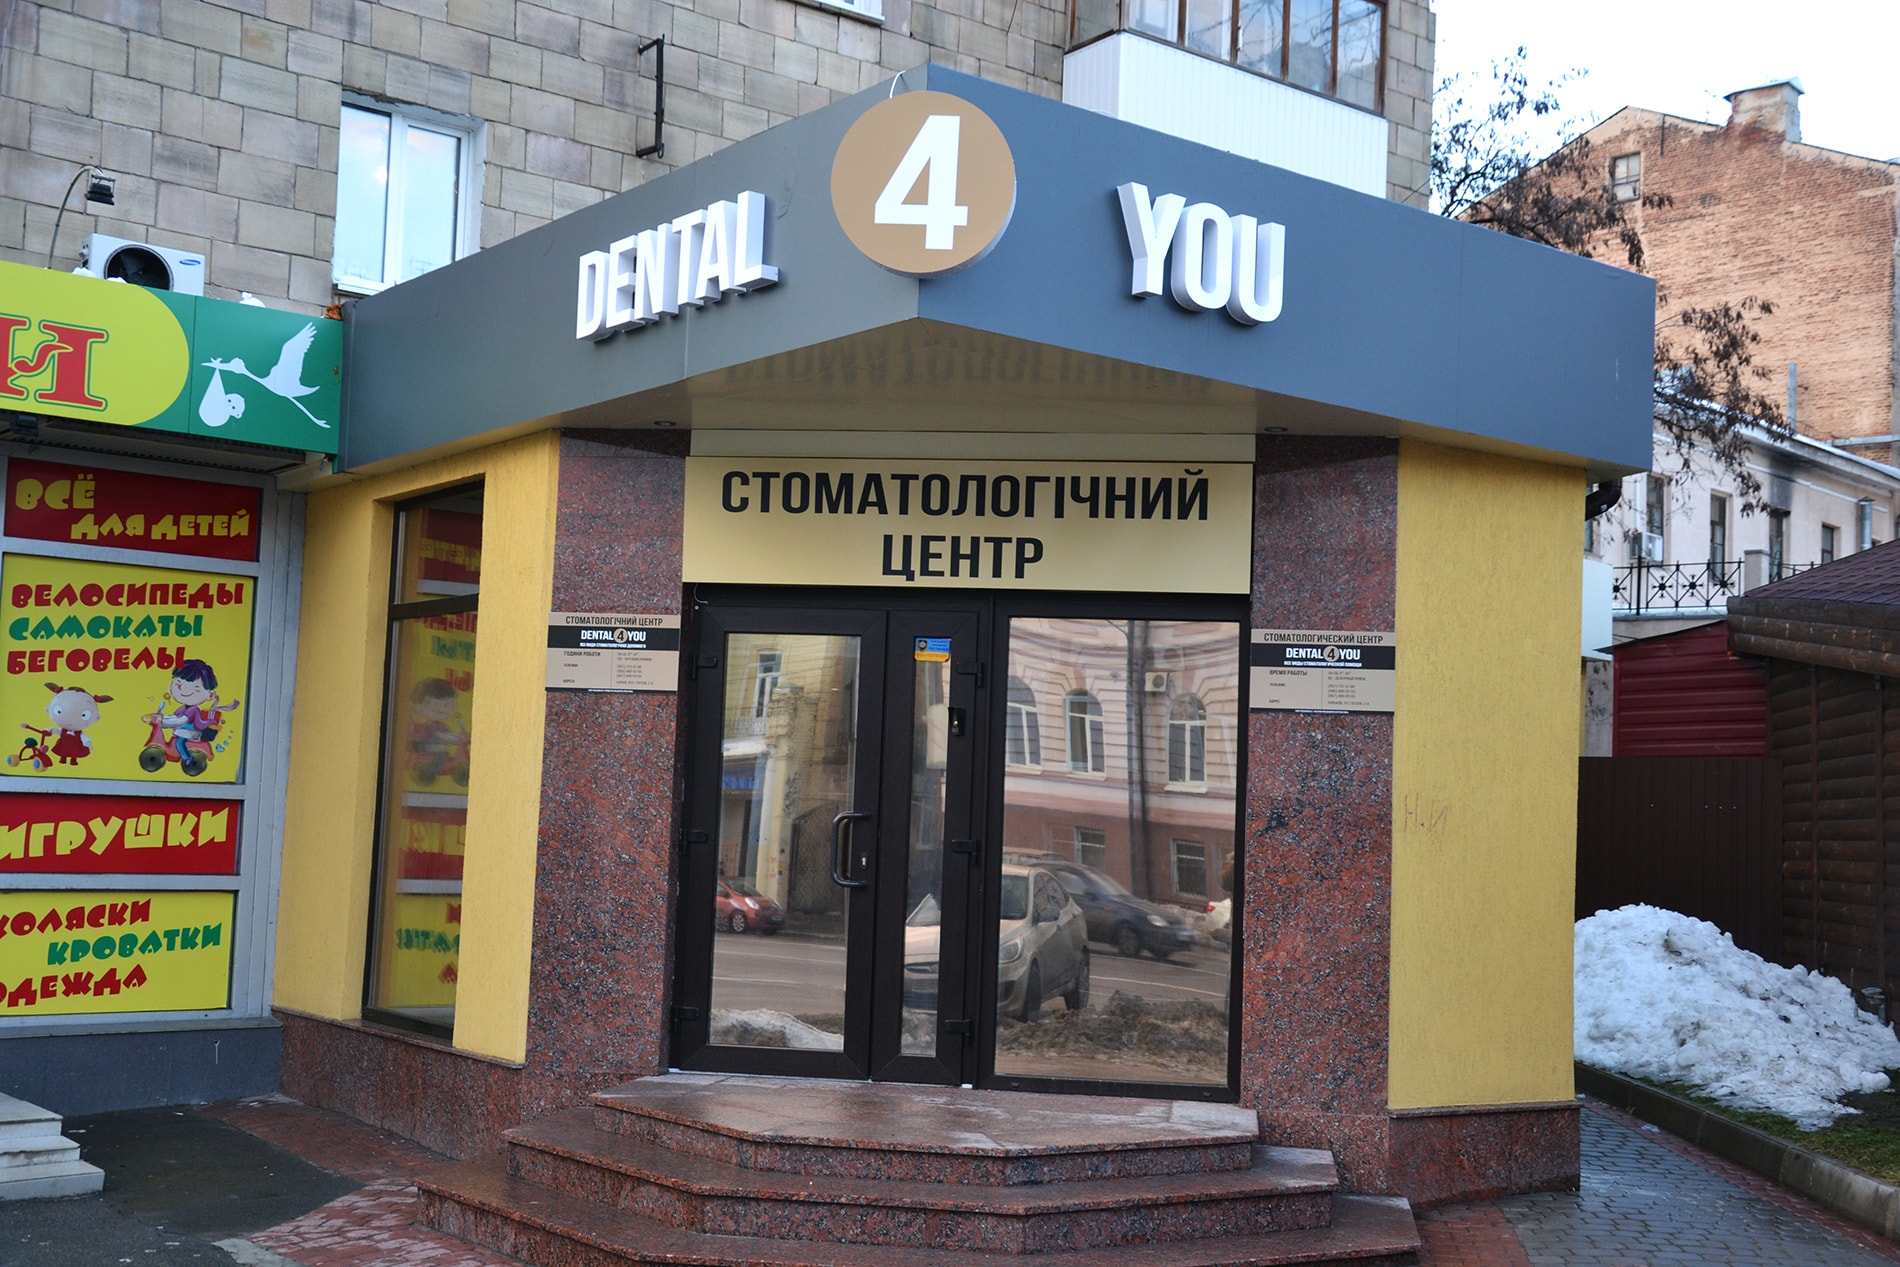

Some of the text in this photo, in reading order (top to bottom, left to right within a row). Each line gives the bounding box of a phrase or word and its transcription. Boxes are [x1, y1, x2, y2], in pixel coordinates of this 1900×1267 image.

[575, 114, 1286, 341] DENTAL 4 YOU
[15, 473, 96, 510] ВСЁ
[721, 468, 1210, 521] СТОМАТОЛОГІЧНИЙ
[70, 508, 250, 541] ДЛЯ ДЕТЕЙ
[882, 534, 1044, 582] ЦЕНТР
[11, 582, 244, 609] ВЕЛОСИПЕДЫ
[8, 613, 204, 641] САМОКАТЫ
[565, 615, 663, 626] СТОМАТОЛОГІЧНИЙ ЦЕНТР
[581, 630, 613, 640] DENTAL
[628, 632, 646, 641] YOU
[1264, 633, 1383, 644] СТОМАТОЛОГИЧЕСКИЙ ЦЕНТР
[1286, 648, 1323, 659] DENTAL
[1340, 649, 1360, 660] YOU
[6, 646, 186, 675] БЕГОВЕЛЫ
[0, 806, 229, 861] ИГРУШКИ
[47, 922, 222, 966] КРОВАТКИ
